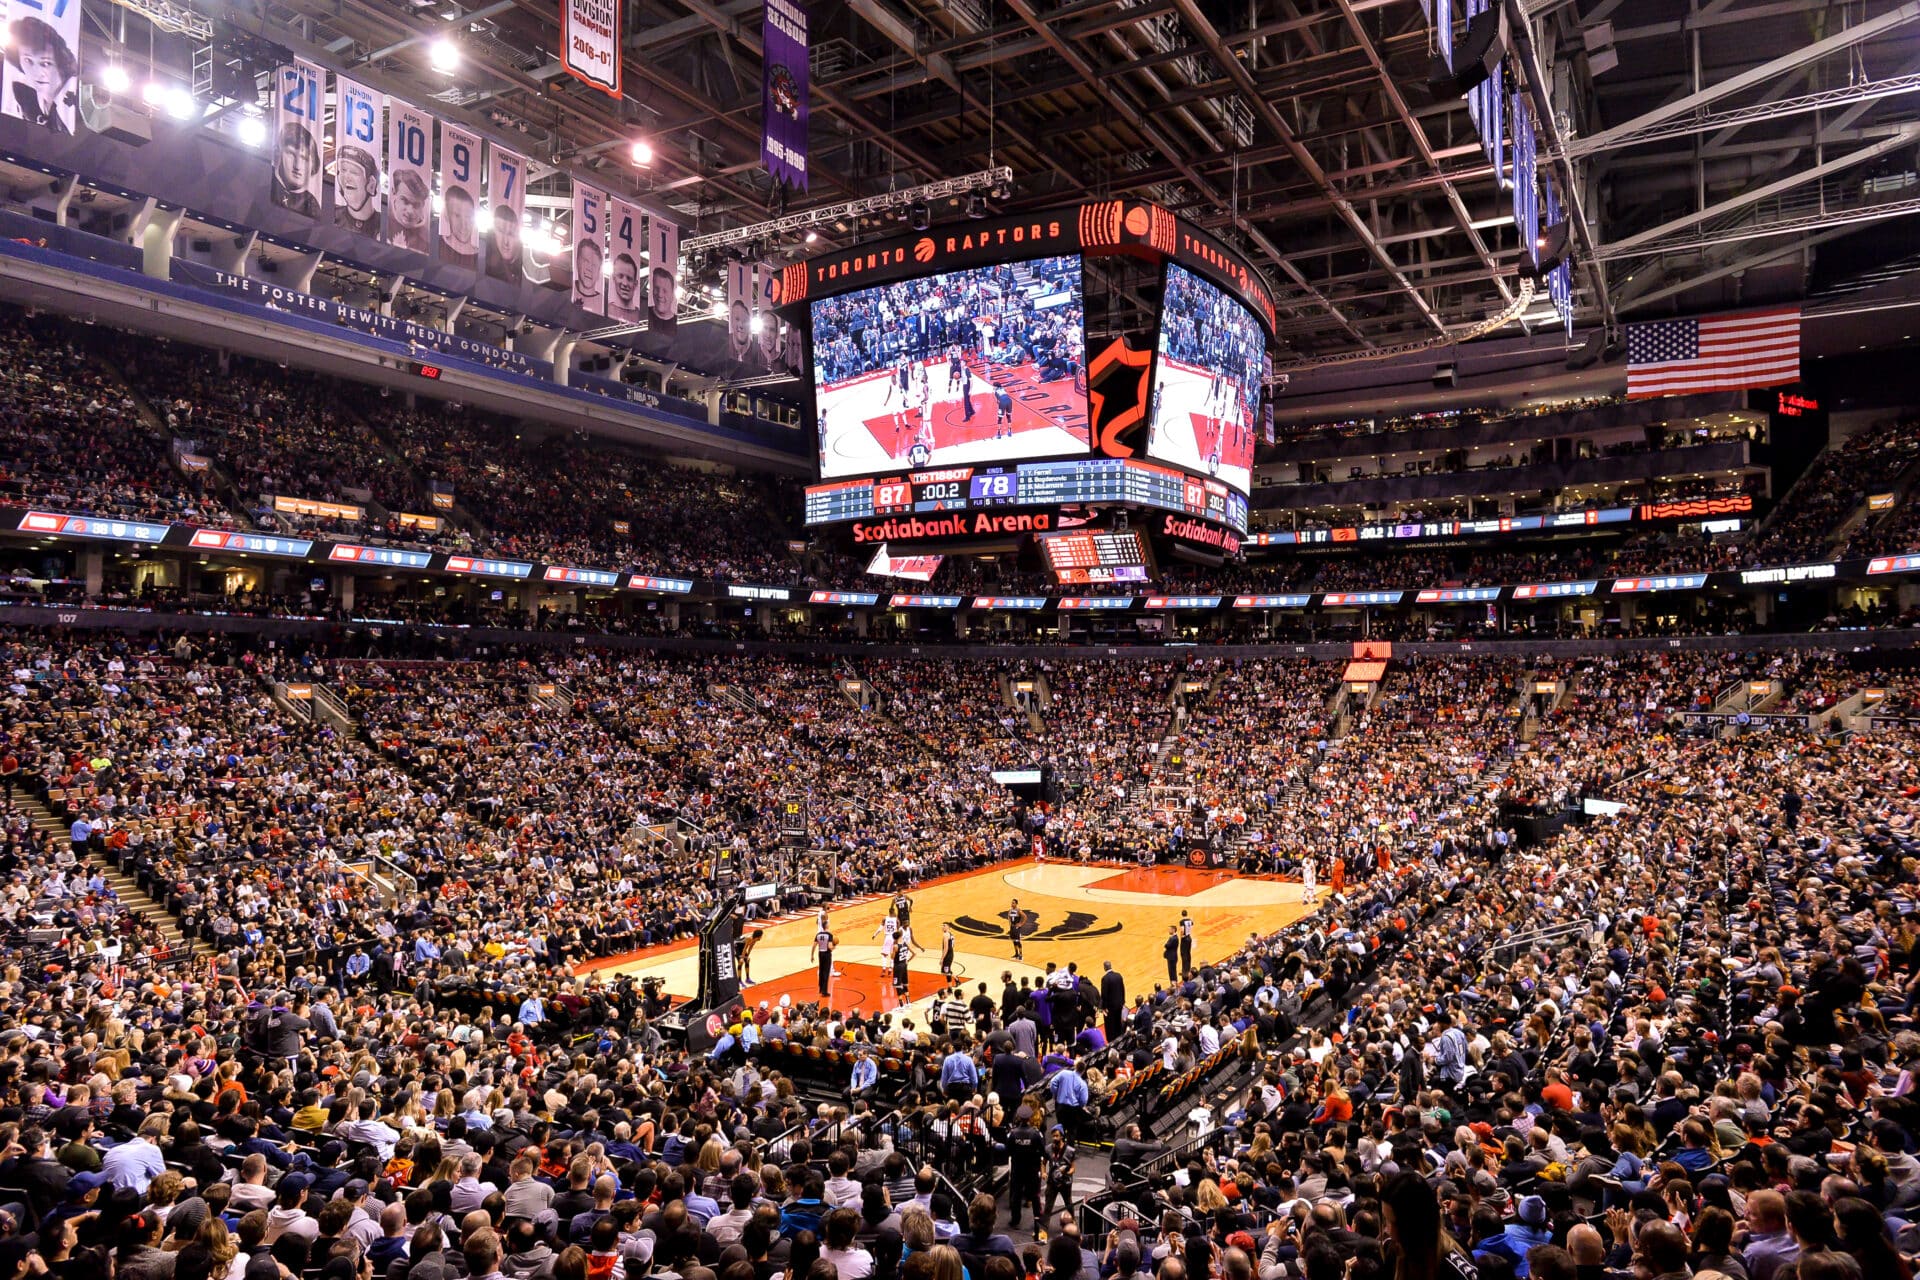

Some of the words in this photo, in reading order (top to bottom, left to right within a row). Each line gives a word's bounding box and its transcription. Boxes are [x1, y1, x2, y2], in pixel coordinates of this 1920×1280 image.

[768, 6, 806, 47] SEASON
[284, 71, 316, 121] 21
[346, 95, 374, 142] 13
[403, 113, 421, 126] APPS
[398, 120, 425, 166] 10
[449, 131, 474, 147] KENNEDY
[453, 144, 470, 182] 9
[497, 152, 520, 166] HORTON
[501, 162, 516, 199] 7
[584, 199, 596, 234] 5
[619, 216, 633, 249] 4
[661, 232, 667, 263] 1
[817, 247, 904, 281] TORONTO
[946, 222, 1060, 253] RAPTORS
[1184, 234, 1236, 278] TORONTO
[216, 272, 249, 291] THE
[262, 285, 326, 311] FOSTER
[337, 306, 396, 330] HEWITT
[406, 326, 452, 346] MEDIA
[461, 340, 526, 365] GONDOLA
[927, 468, 969, 481] TISSOT
[979, 476, 1009, 495] 78
[879, 485, 904, 505] 87
[922, 483, 959, 500] :00.2
[1187, 485, 1202, 506] 87
[853, 514, 968, 542] Scotiabank
[974, 513, 1049, 534] Arena
[1163, 514, 1223, 546] Scotiabank
[288, 542, 294, 553] 7
[1741, 569, 1786, 584] TORONTO
[1786, 564, 1835, 580] RAPTORS
[759, 588, 789, 600] RAPTORS
[58, 614, 77, 623] 107
[787, 804, 798, 813] 0.2
